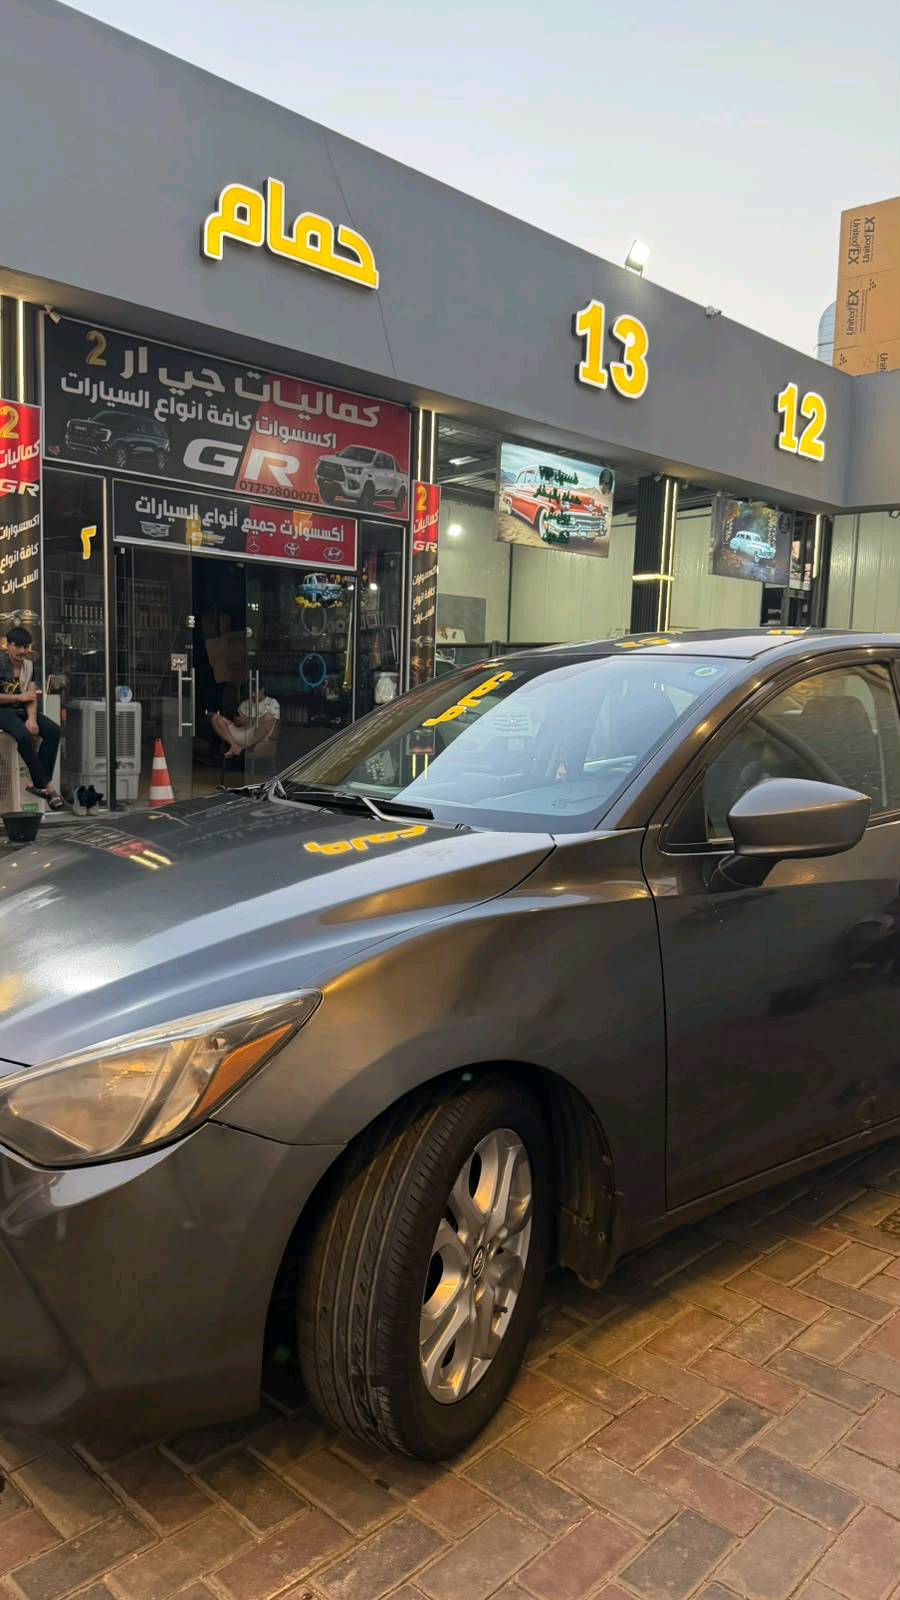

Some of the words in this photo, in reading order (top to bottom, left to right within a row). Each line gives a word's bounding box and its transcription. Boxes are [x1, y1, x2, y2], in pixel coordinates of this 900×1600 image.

[203, 176, 380, 290] حمام
[86, 330, 108, 366] 2
[119, 346, 149, 379] ار
[576, 299, 649, 400] 13
[60, 372, 150, 410] السيارات
[157, 366, 226, 402] جي
[154, 395, 203, 423] انواع
[234, 371, 381, 428] كماليات
[0, 405, 20, 439] 2
[206, 404, 253, 431] كافة
[777, 382, 827, 462] 12
[183, 438, 300, 488] GR
[0, 478, 40, 497] GR
[415, 485, 428, 512] 2
[134, 496, 199, 522] السيارات
[201, 507, 238, 530] أنواع
[240, 517, 277, 537] جميع
[19, 541, 39, 561] كافة
[413, 540, 438, 553] GR
[1, 568, 39, 595] السيارات
